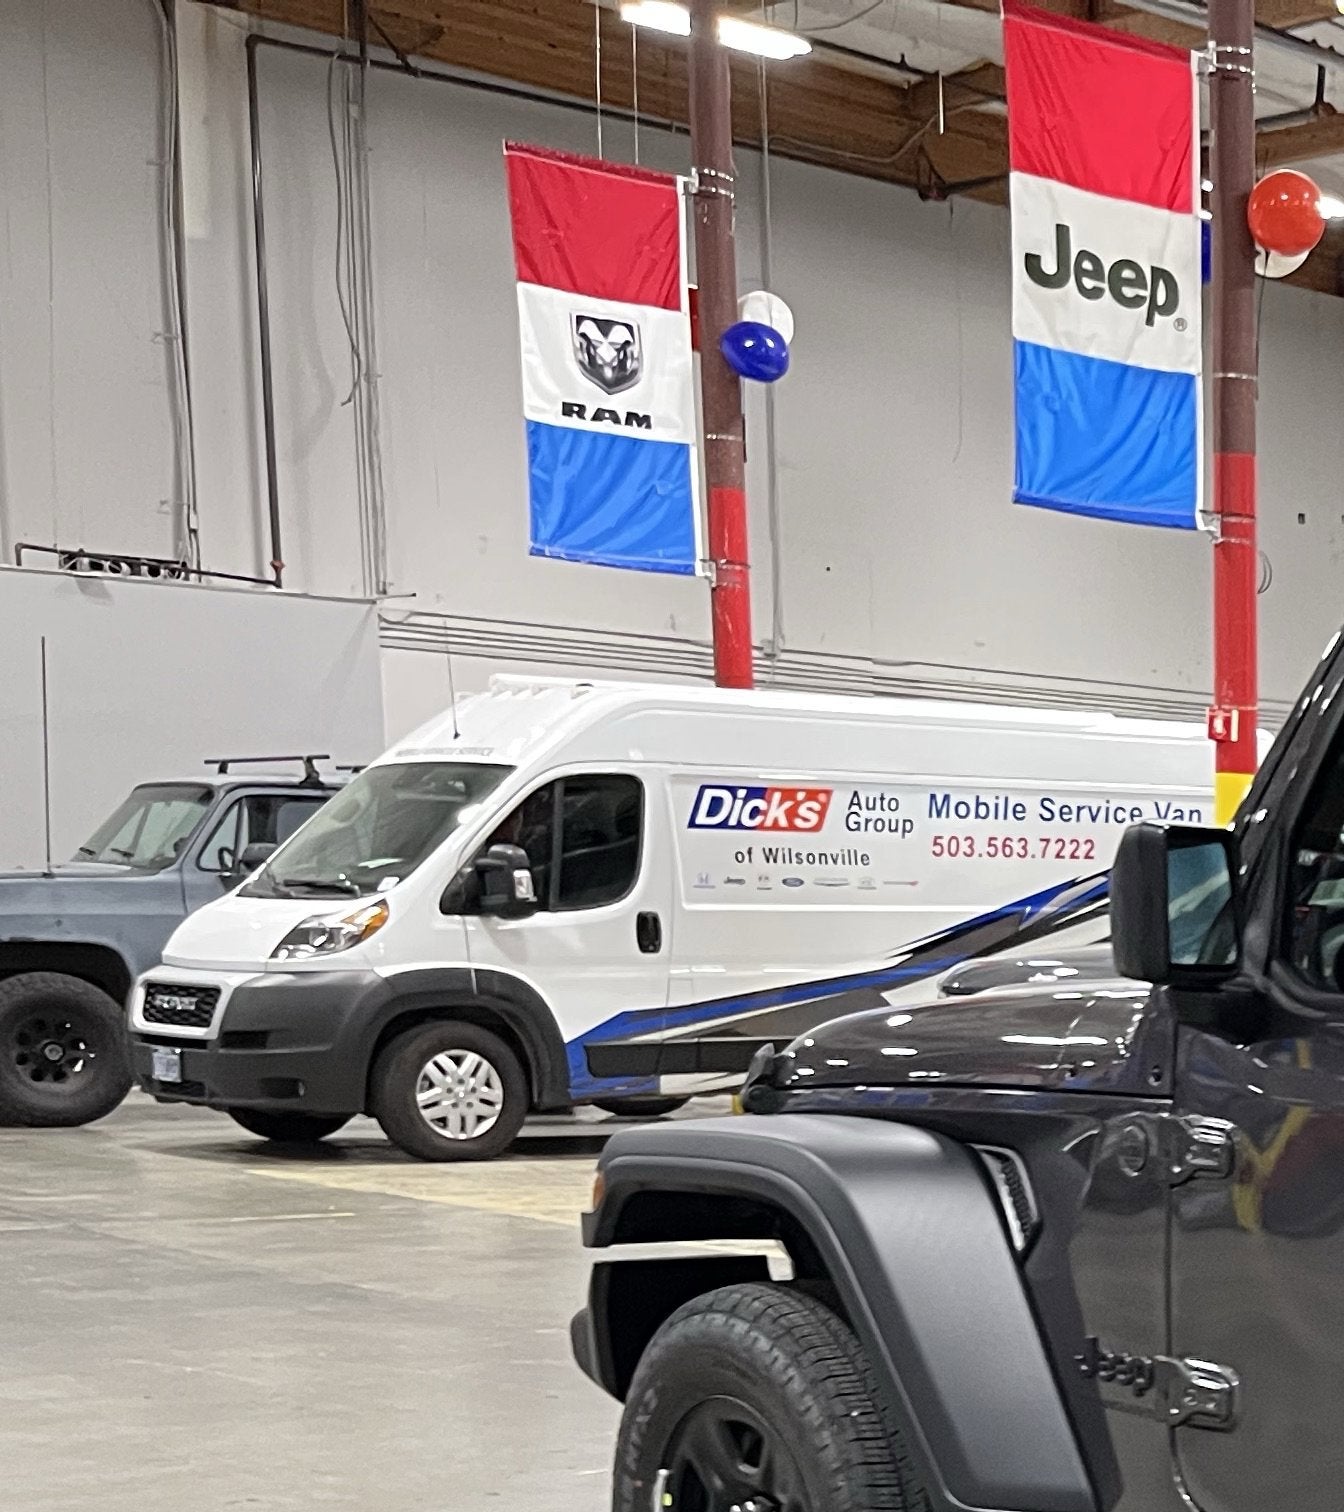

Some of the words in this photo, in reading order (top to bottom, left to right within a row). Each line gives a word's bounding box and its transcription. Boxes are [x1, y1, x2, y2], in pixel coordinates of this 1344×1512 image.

[1024, 223, 1180, 328] Jeep
[561, 401, 653, 430] RAM
[694, 788, 823, 830] Dick's
[847, 790, 901, 813] Auto
[928, 793, 1027, 822] Mobile
[1038, 797, 1144, 824] Service
[1154, 801, 1203, 823] Van
[845, 811, 915, 839] Group
[734, 848, 754, 865] of
[761, 847, 871, 867] Wilsonville
[931, 835, 1096, 861] 503.563.7222
